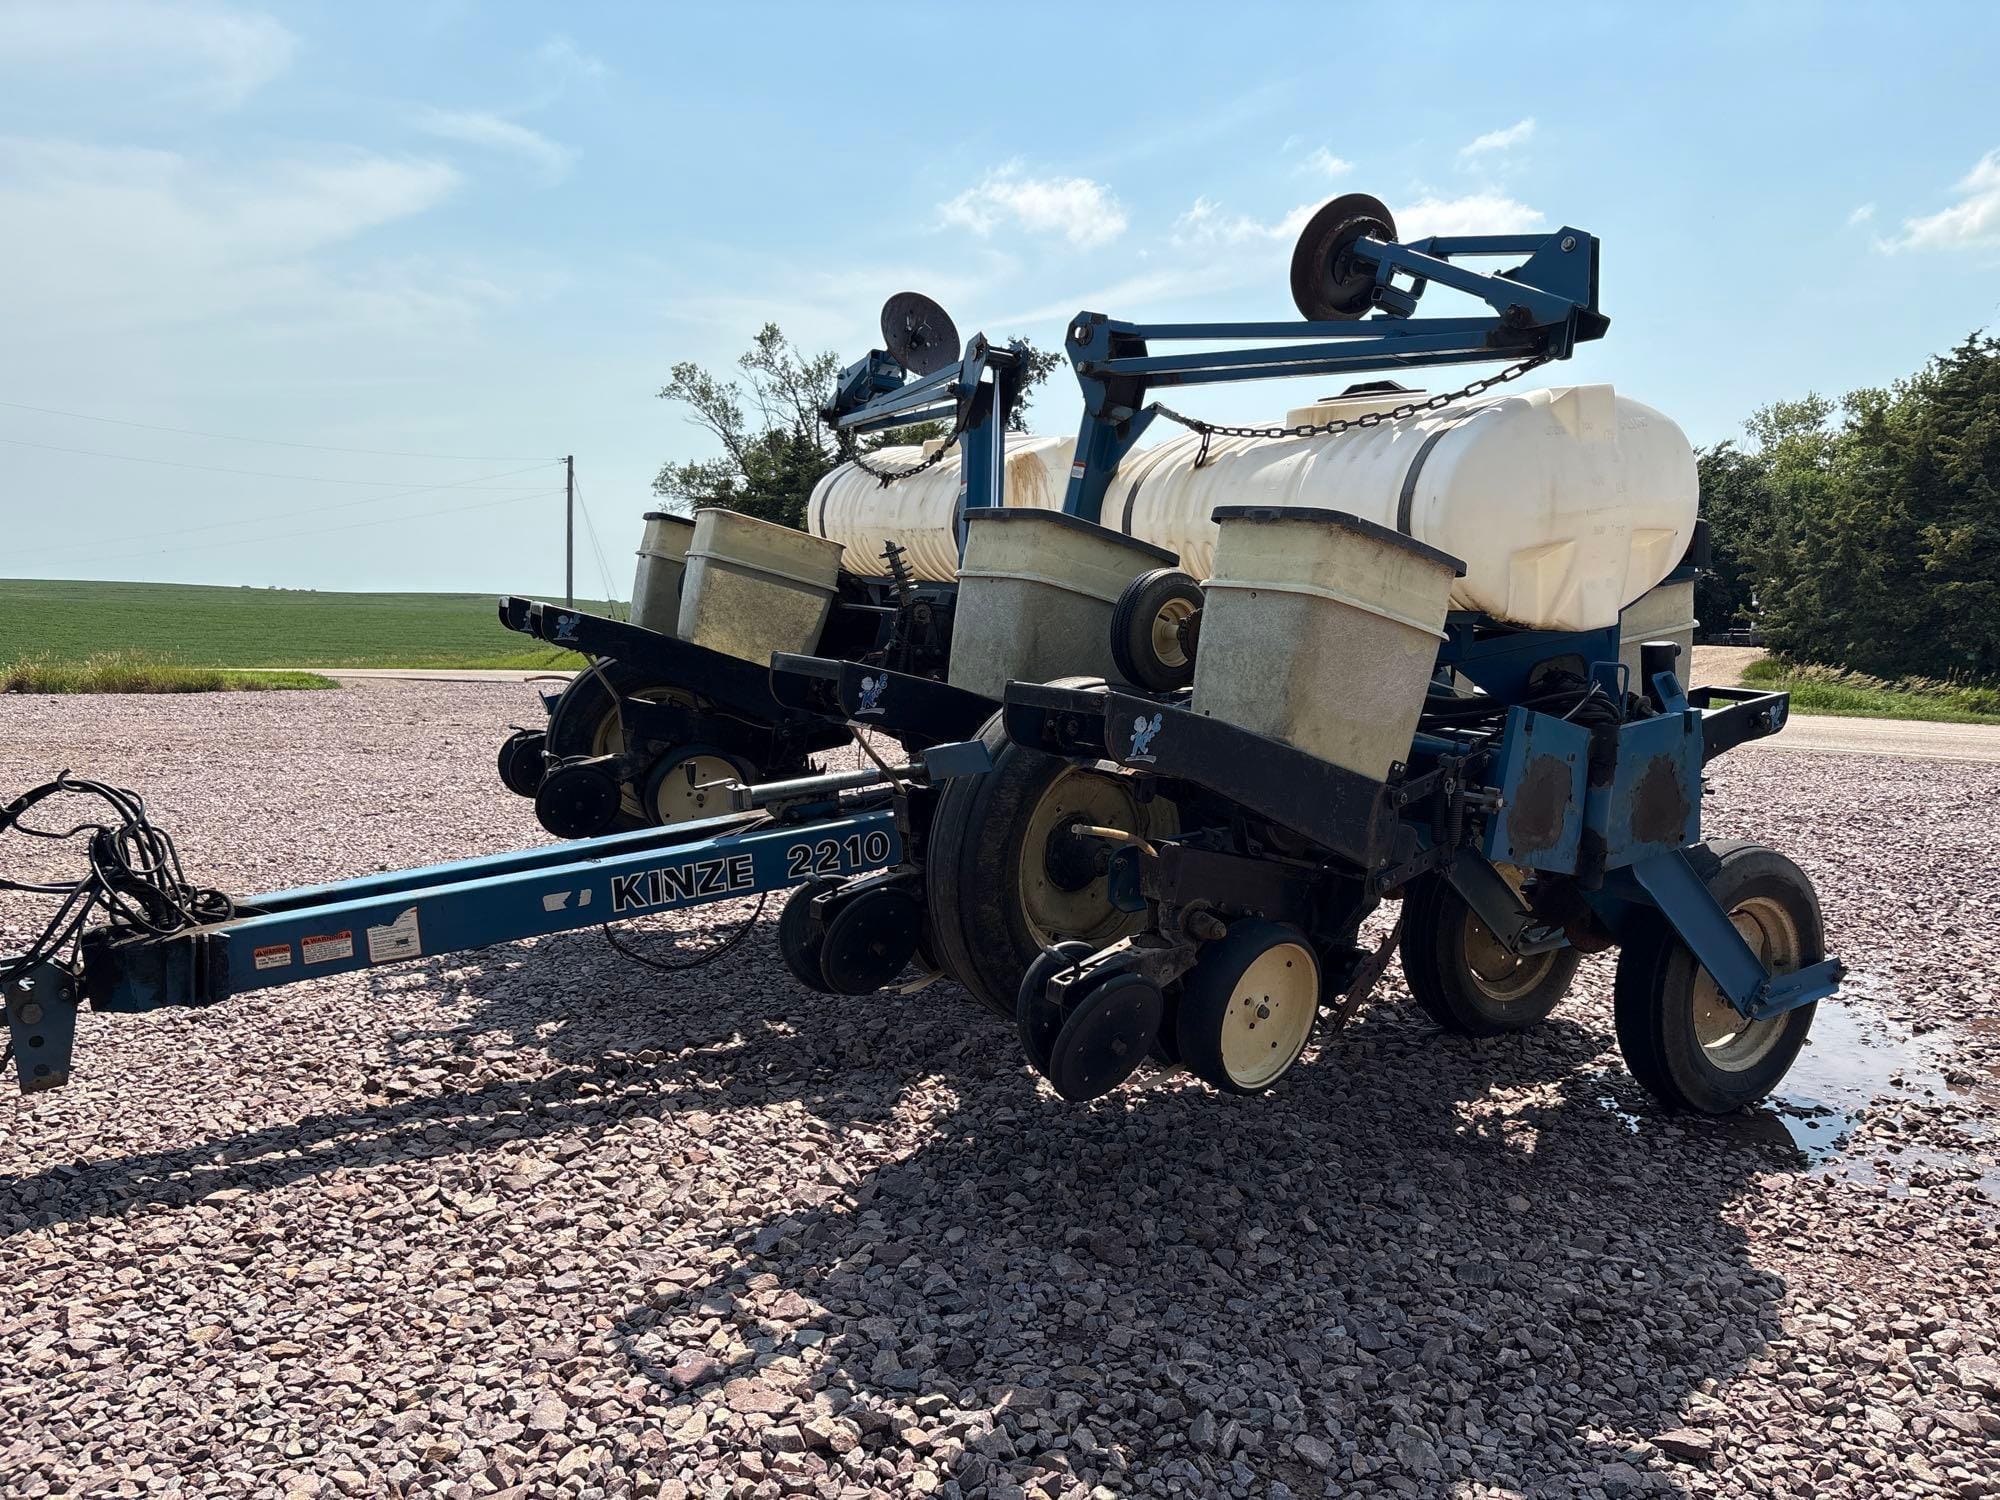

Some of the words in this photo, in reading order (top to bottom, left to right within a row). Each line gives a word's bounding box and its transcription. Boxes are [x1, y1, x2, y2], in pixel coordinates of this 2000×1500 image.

[611, 854, 754, 912] KINZE
[787, 831, 890, 878] 2210
[310, 933, 344, 944] WARNING
